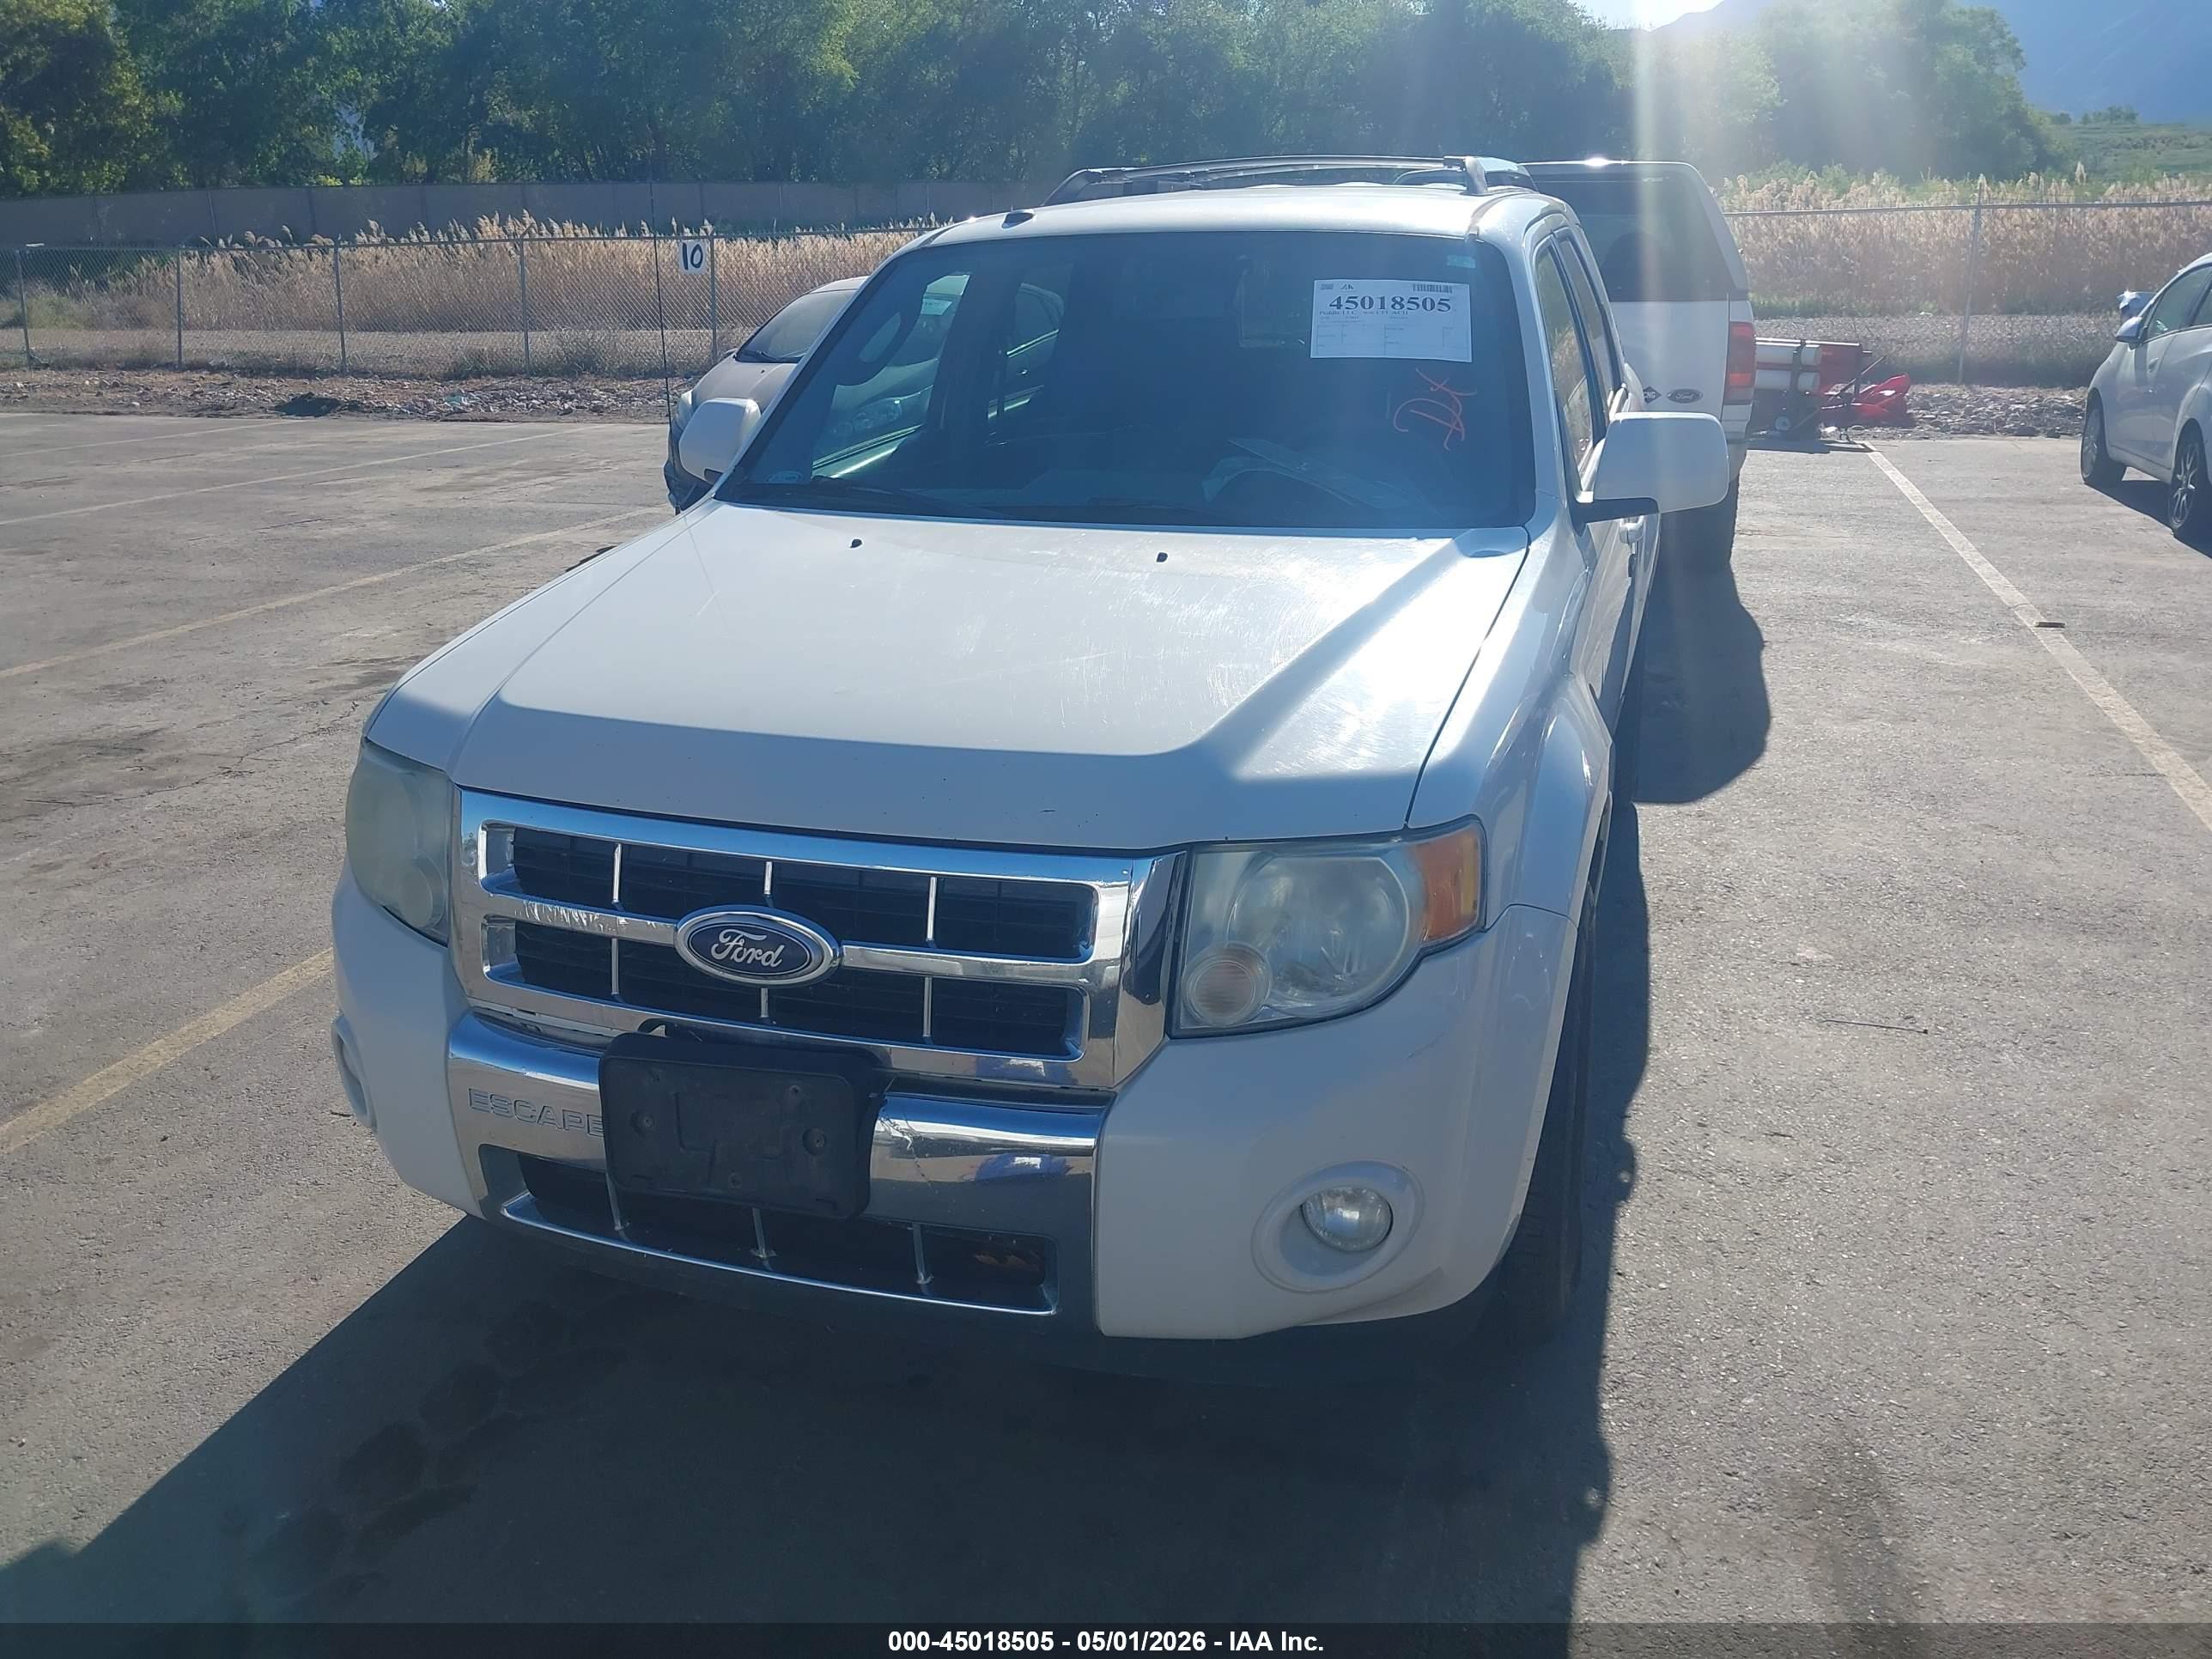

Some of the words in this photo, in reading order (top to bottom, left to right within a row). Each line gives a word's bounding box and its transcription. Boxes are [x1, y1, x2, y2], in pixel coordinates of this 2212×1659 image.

[682, 242, 704, 270] 10
[1328, 295, 1451, 313] 45018505
[710, 928, 785, 968] Ford
[468, 1088, 605, 1138] ESCAPE
